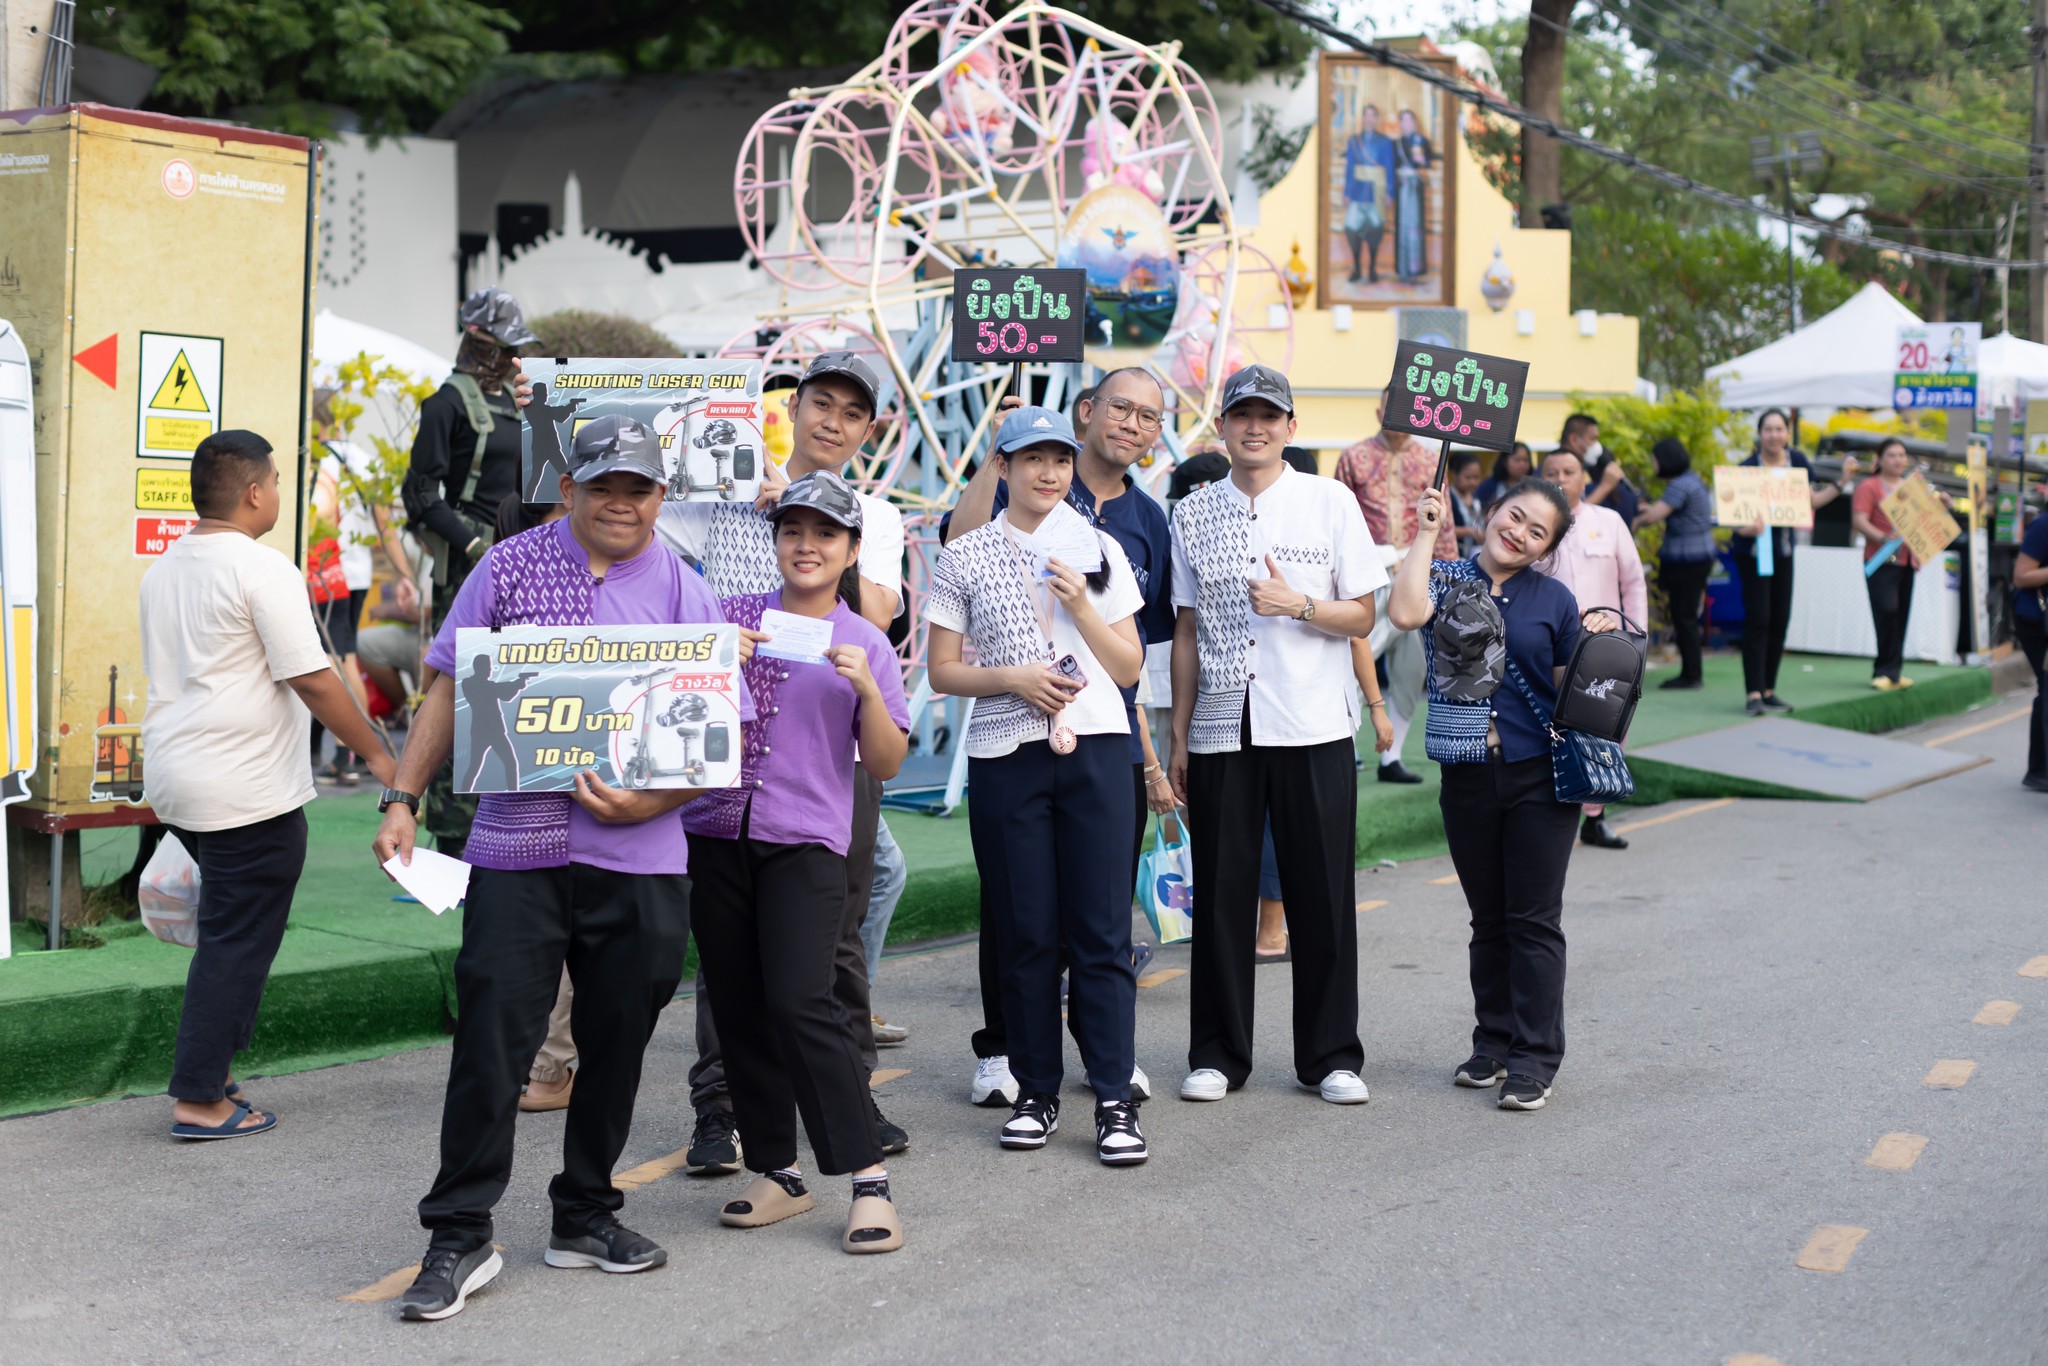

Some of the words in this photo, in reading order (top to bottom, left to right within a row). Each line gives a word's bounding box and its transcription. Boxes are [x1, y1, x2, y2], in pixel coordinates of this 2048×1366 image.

[966, 275, 1071, 319] ยิงปืน
[976, 322, 1057, 354] 50.-
[555, 374, 643, 389] SHOOTING
[648, 374, 704, 389] LASER
[708, 374, 746, 389] GUN
[1406, 352, 1509, 409] ยิงปืน
[710, 406, 748, 415] REWARD
[1409, 395, 1492, 435] 50.-
[143, 491, 177, 502] STAFF
[146, 539, 164, 551] NO
[498, 634, 717, 664] เกมยิงปืนเลเซอร์
[675, 675, 722, 689] รางวัล
[515, 696, 585, 734] 50
[585, 712, 634, 731] บาท
[535, 748, 560, 766] 10
[563, 746, 596, 765] นัด
